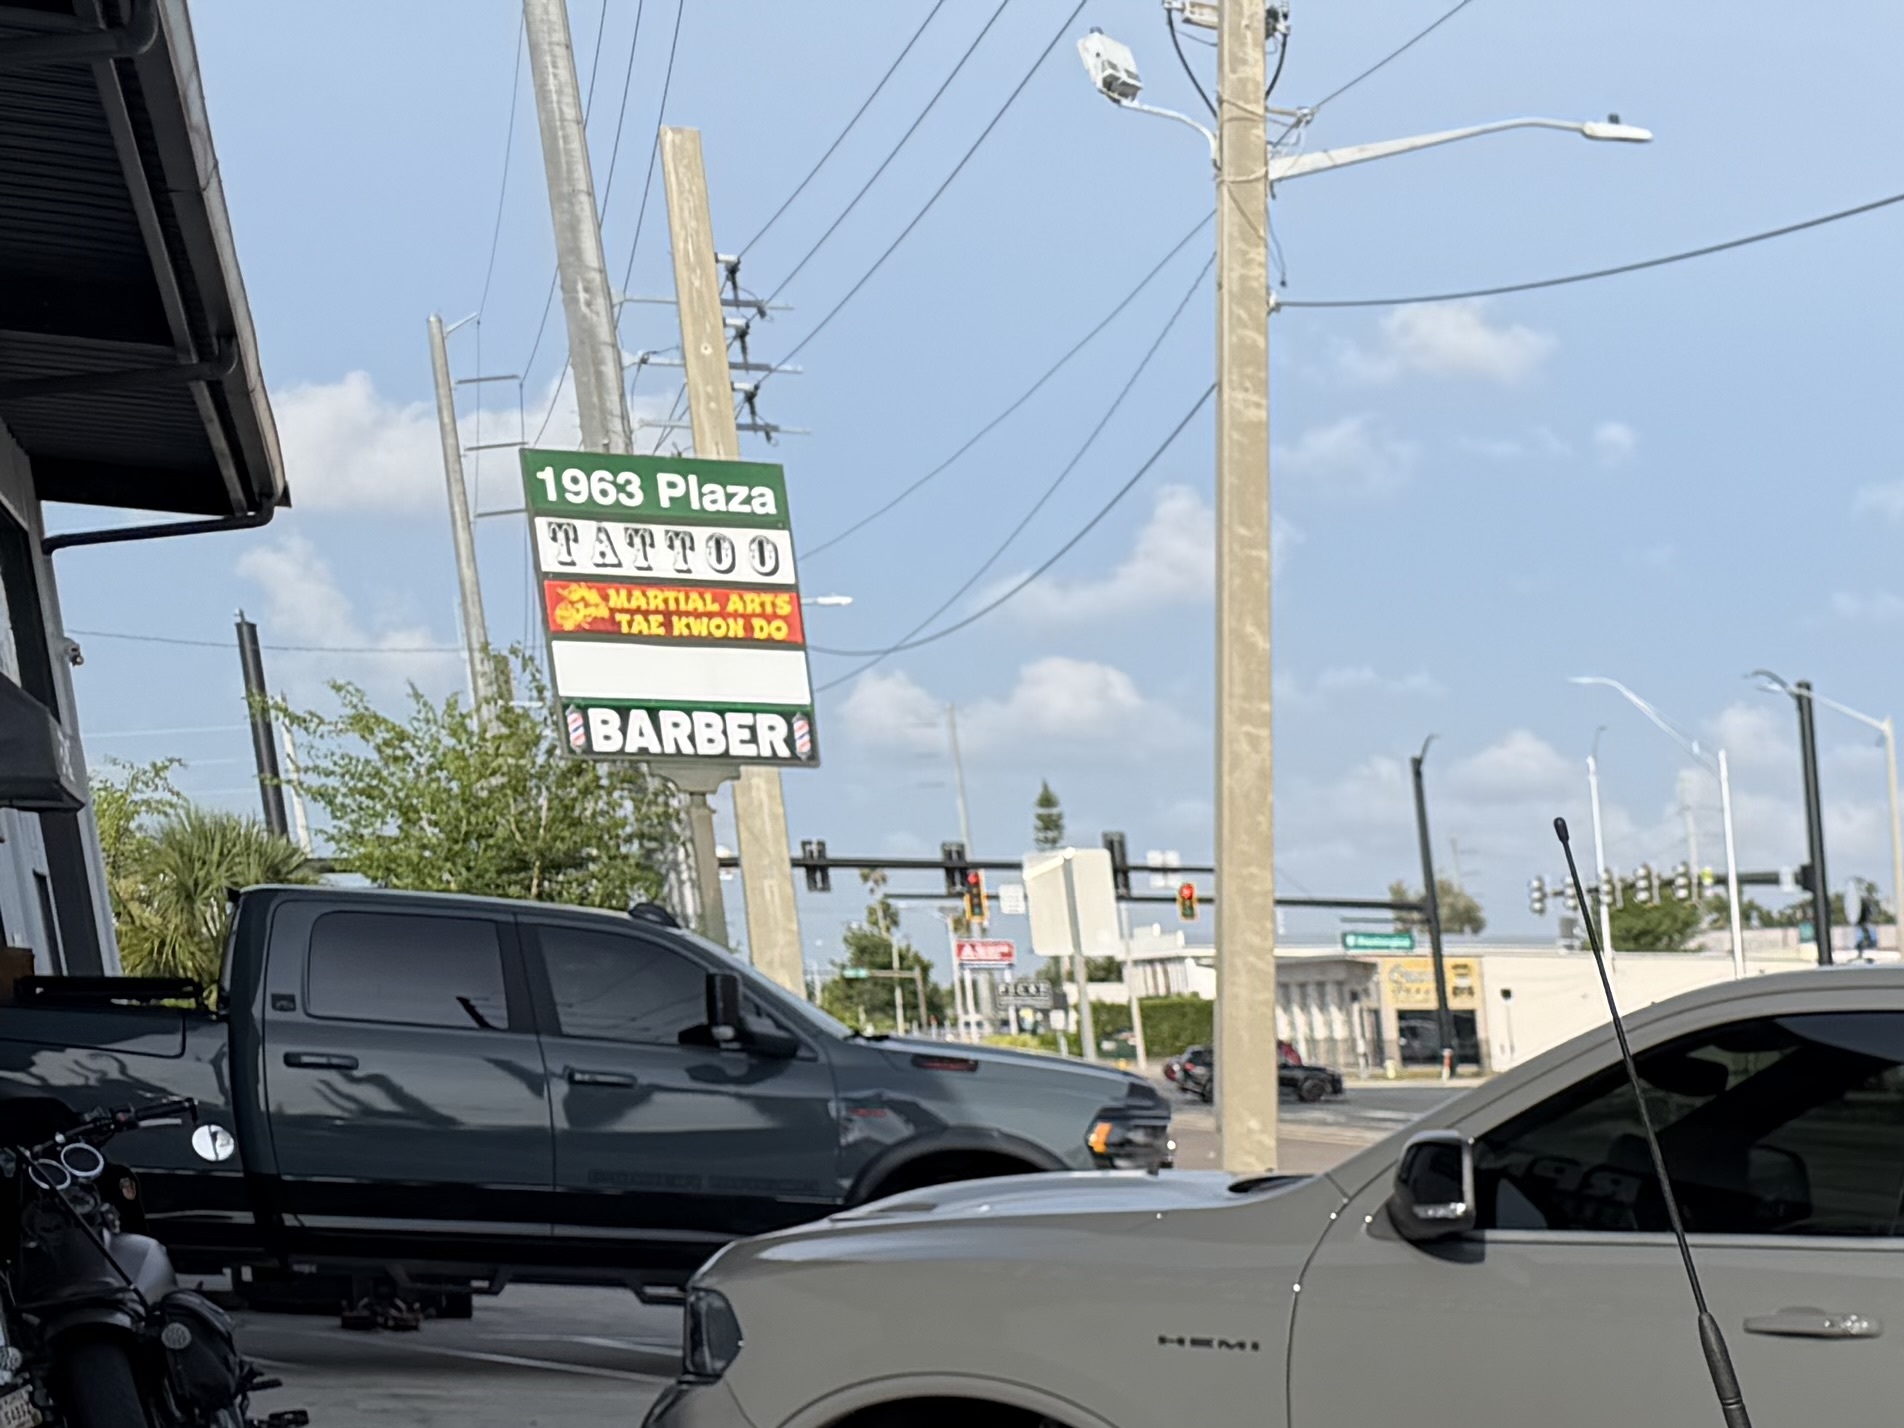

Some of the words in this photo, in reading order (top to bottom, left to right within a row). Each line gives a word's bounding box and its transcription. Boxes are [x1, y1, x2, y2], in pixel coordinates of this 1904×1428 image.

[536, 466, 645, 507] 1963
[656, 473, 777, 515] Plaza
[547, 521, 780, 576] TATTOO
[608, 588, 720, 612] MARTIAL
[726, 593, 792, 616] ARTS
[615, 613, 665, 636] TAE
[672, 616, 745, 638] KWON
[752, 619, 789, 641] DO
[587, 707, 792, 758] BARBER
